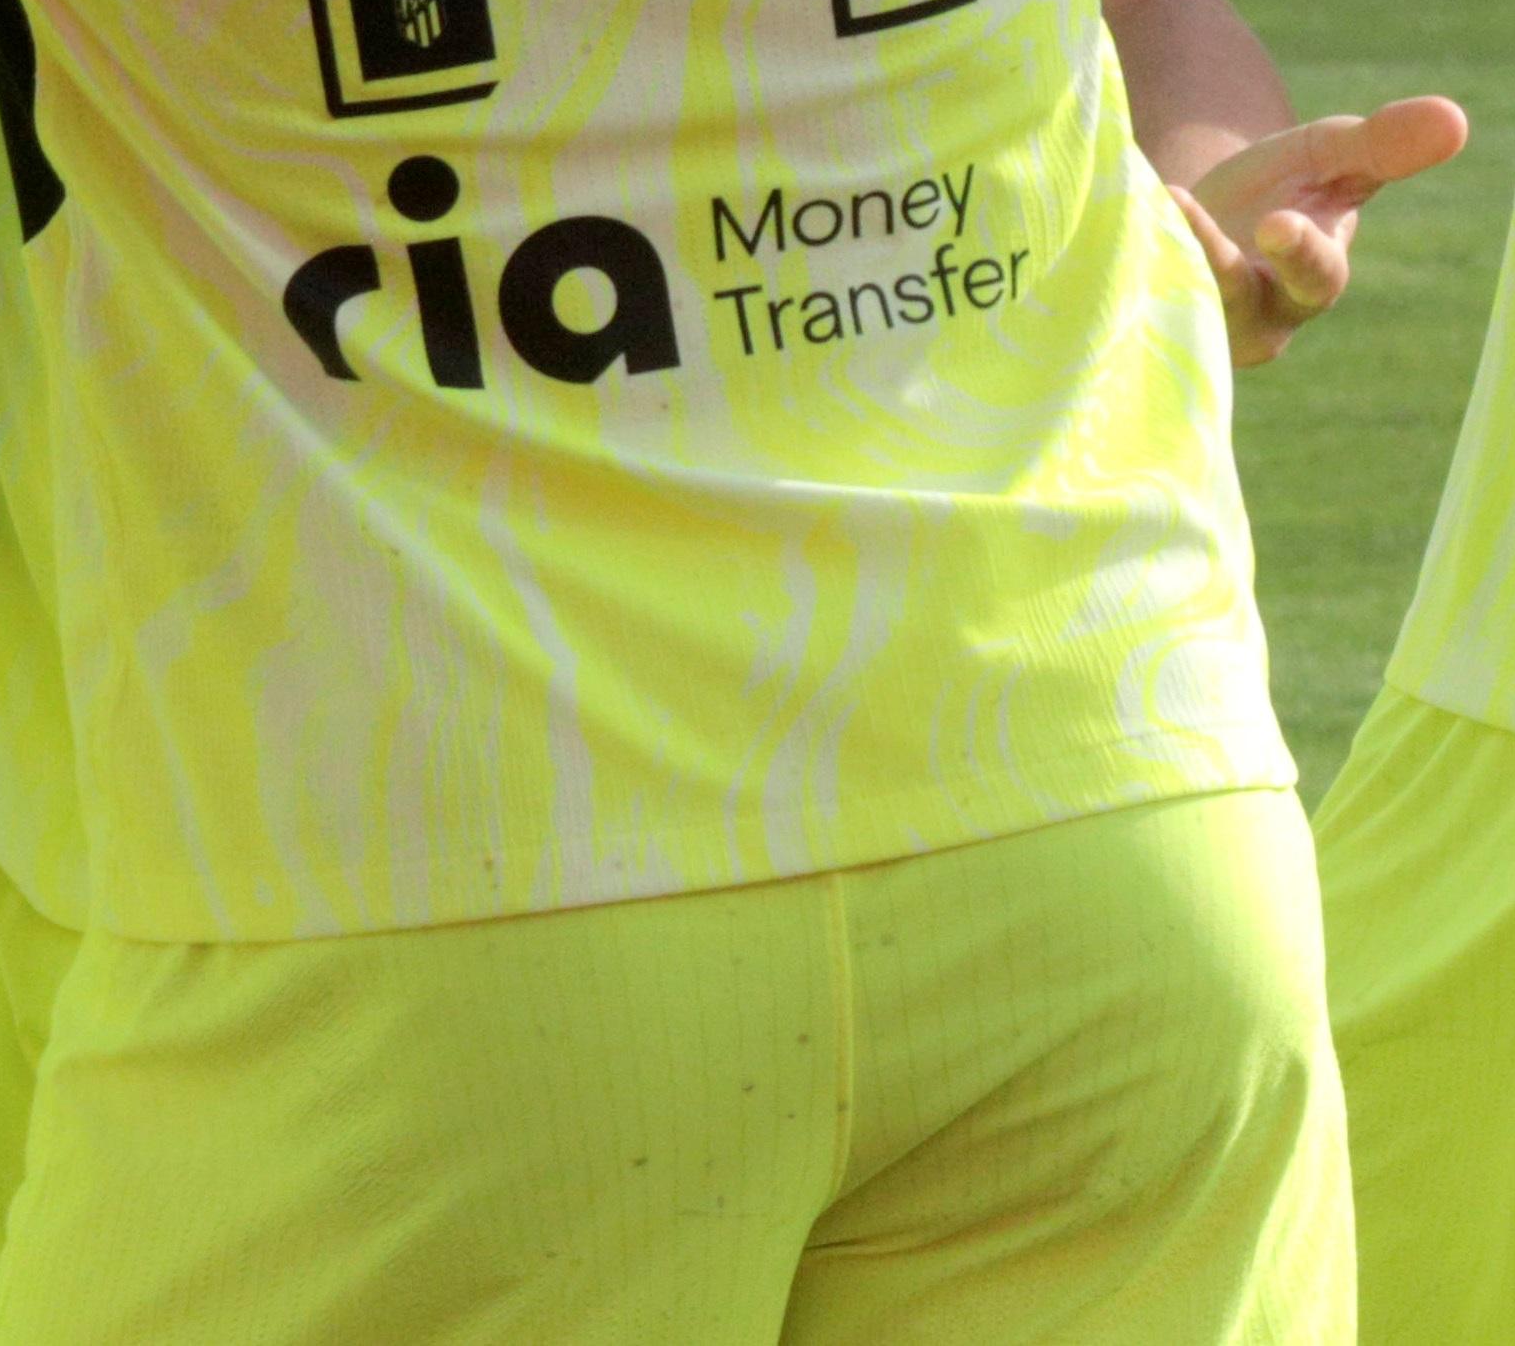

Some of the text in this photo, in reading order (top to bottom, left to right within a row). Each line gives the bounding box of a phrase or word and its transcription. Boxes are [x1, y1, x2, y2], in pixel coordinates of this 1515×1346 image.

[710, 164, 976, 264] Money
[282, 154, 681, 390] ria
[712, 242, 1033, 357] Transfer
